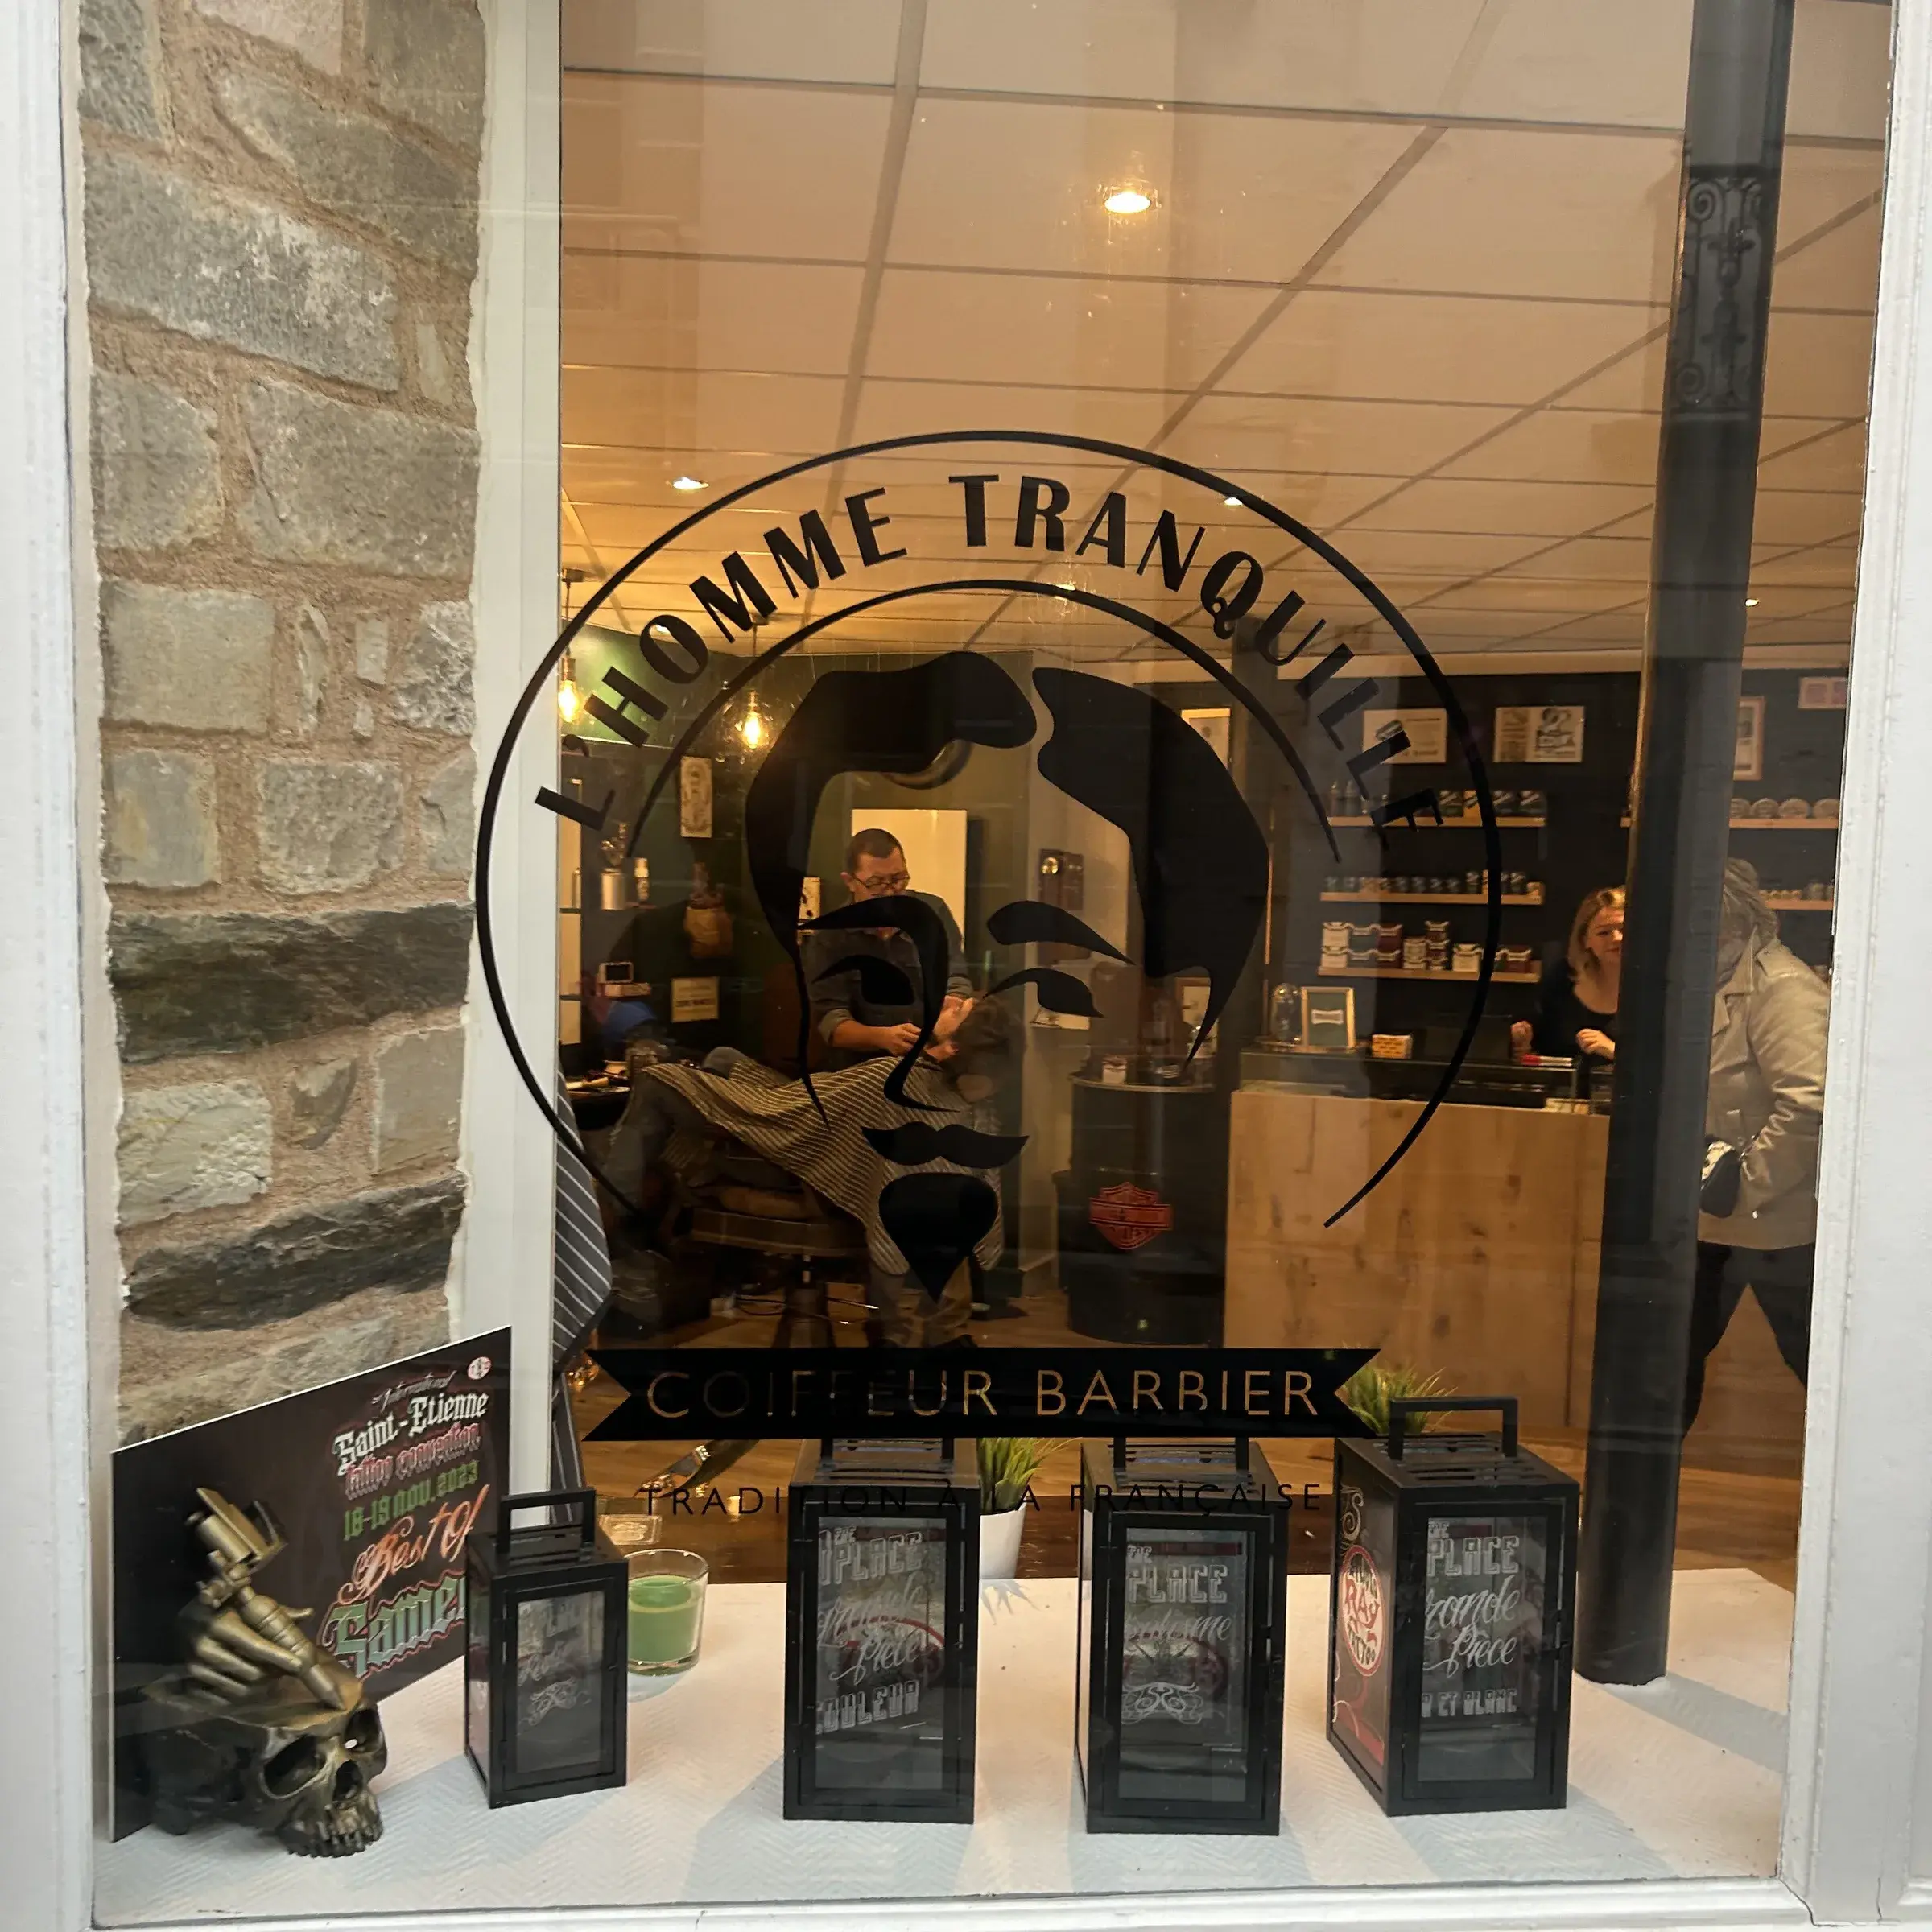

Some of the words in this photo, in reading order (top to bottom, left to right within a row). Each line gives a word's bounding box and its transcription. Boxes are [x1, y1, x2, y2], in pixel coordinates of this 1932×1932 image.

[535, 487, 907, 831] L'HOMME
[948, 474, 1443, 851] TRANQUILLE
[647, 1369, 998, 1418] COIFFEUR
[1036, 1369, 1319, 1416] BARBIER
[642, 1486, 906, 1516] TRADITION
[1070, 1484, 1321, 1517] FRANÇAISE
[337, 1502, 452, 1605] Best
[834, 1531, 923, 1584] PLACE
[1426, 1535, 1520, 1577] PLACE
[1128, 1564, 1228, 1604] PLACE
